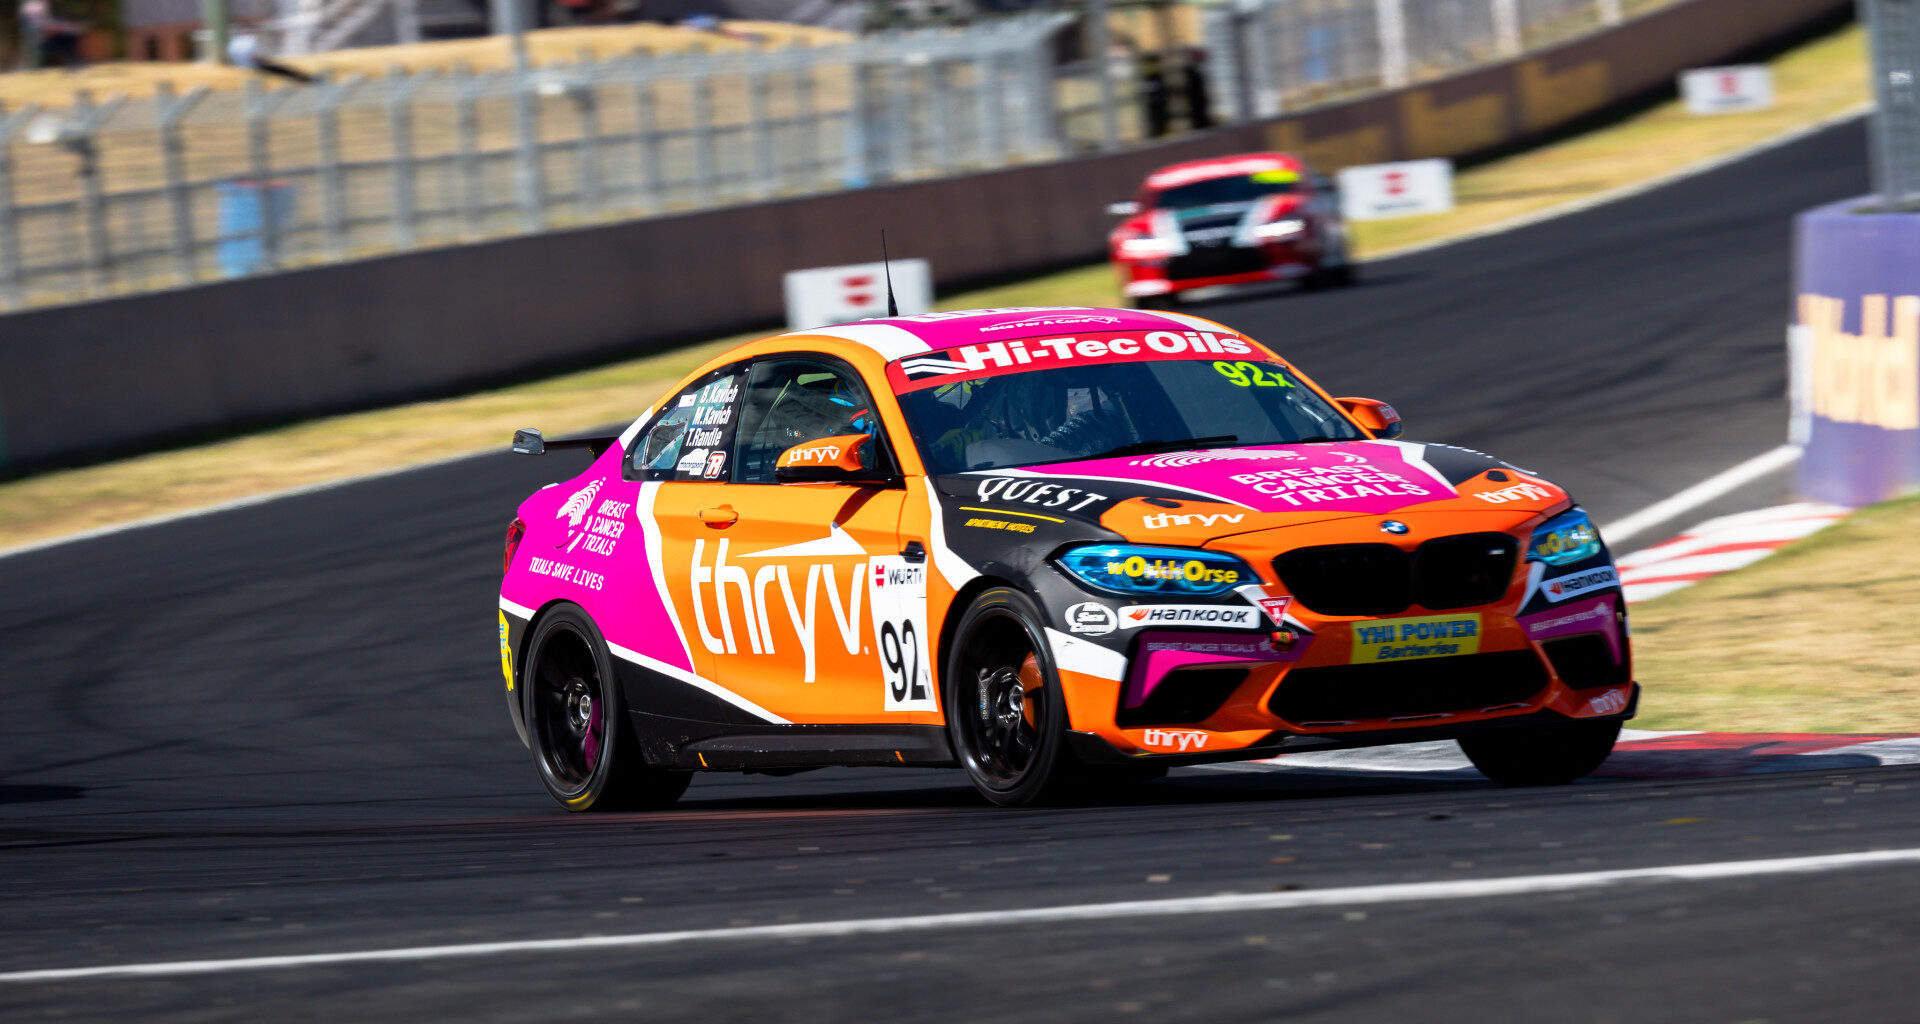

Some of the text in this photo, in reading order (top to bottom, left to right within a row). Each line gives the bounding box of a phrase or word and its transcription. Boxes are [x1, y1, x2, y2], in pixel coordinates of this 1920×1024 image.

[959, 331, 1251, 371] Hi-Tec Oils
[1213, 361, 1295, 387] 92x
[788, 447, 840, 464] thryv
[1229, 465, 1382, 484] BREAST
[1253, 473, 1410, 494] CANCER
[977, 477, 1108, 512] QUEST
[1272, 483, 1430, 506] TRIALS
[1473, 485, 1552, 503] thryv
[598, 499, 630, 519] BREAST
[591, 515, 625, 539] CANCER
[1143, 513, 1244, 529] thryv
[582, 533, 616, 556] TRIALS
[529, 557, 604, 591] TRIALS SAVE LIVES
[690, 537, 868, 684] thryv
[1356, 620, 1477, 644] YHI POWER
[1376, 642, 1459, 660] Batteries
[1144, 729, 1208, 751] thryv
